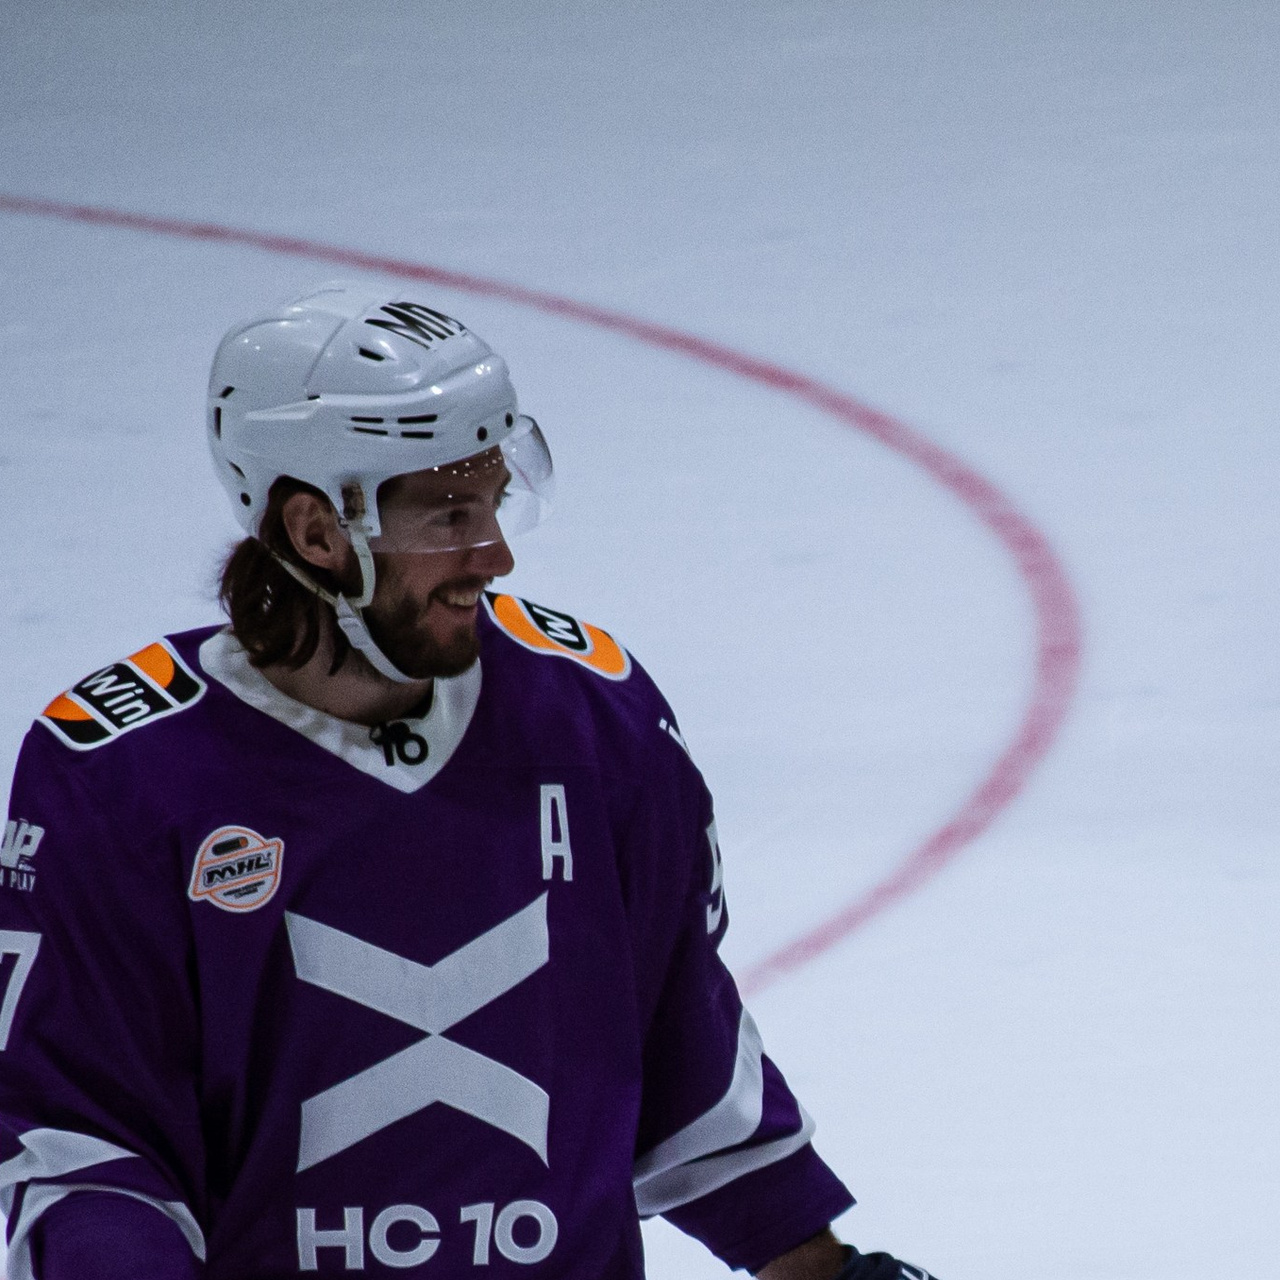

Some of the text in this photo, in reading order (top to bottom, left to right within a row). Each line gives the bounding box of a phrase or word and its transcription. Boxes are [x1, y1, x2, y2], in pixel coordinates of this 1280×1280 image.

[81, 664, 151, 724] Win
[540, 784, 574, 882] A
[297, 1199, 559, 1271] HC 10
